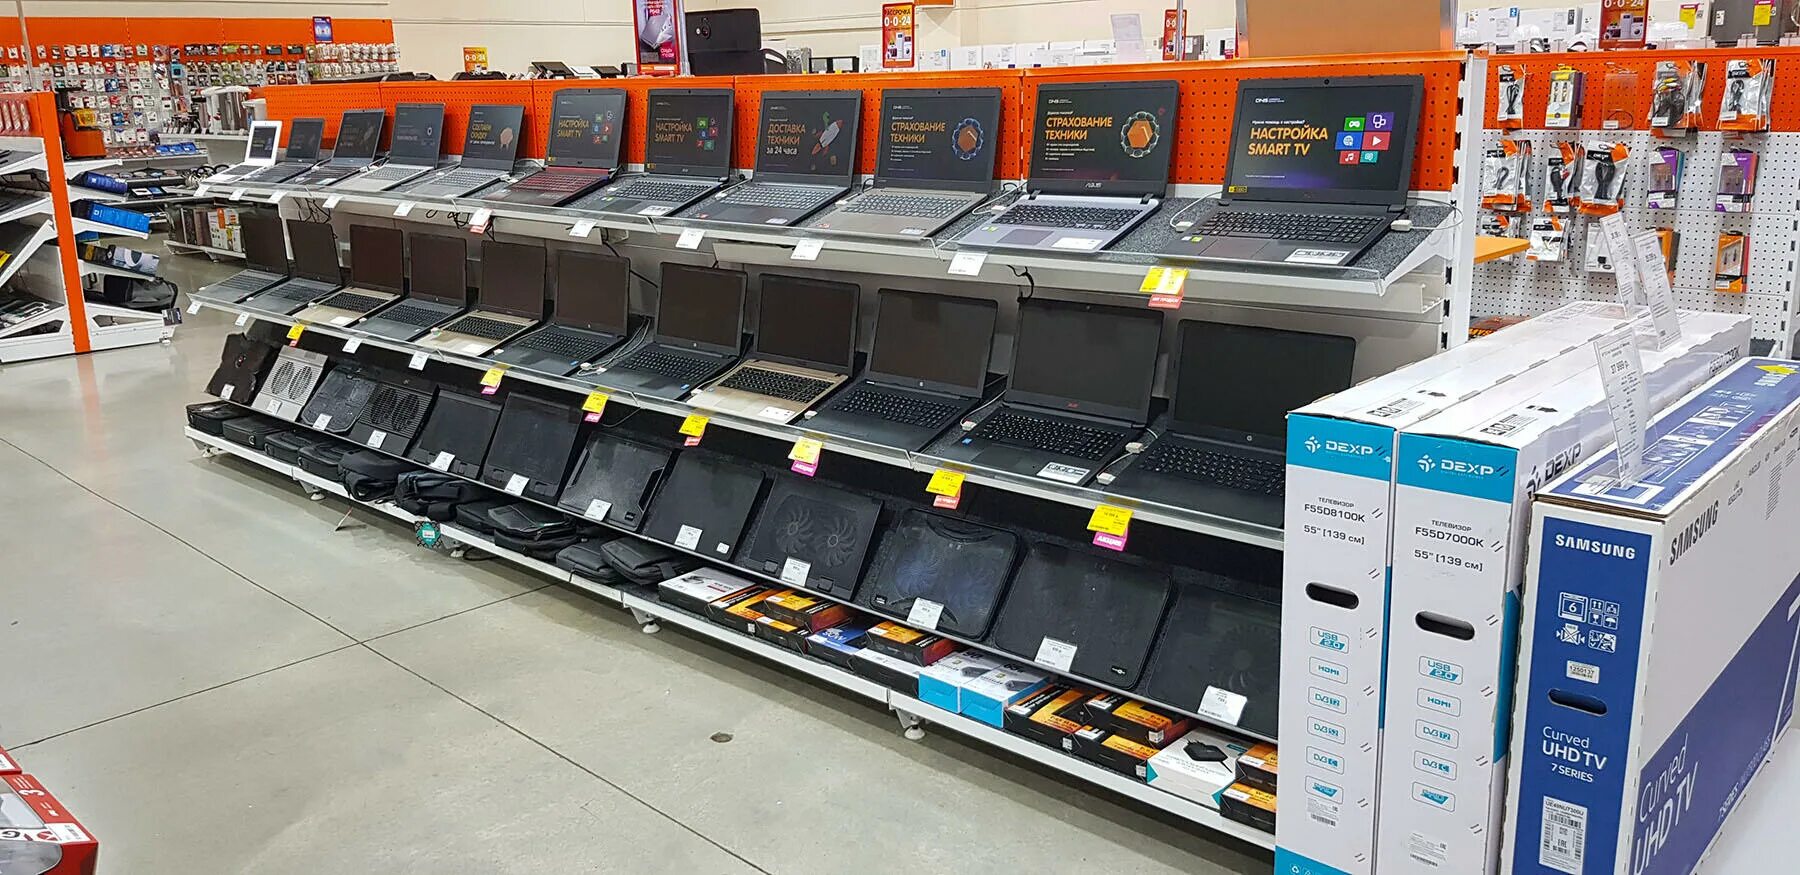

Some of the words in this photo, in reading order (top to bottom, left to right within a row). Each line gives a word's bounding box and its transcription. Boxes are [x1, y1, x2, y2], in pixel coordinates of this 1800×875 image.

[655, 121, 693, 132] НАСТРОЙКА
[891, 122, 946, 131] СТРАХОВАНИЕ
[1046, 117, 1113, 127] СТРАХОВАНИЕ
[767, 123, 806, 134] ДОСТАВКА
[1250, 124, 1328, 140] НАСТРОЙКА
[655, 133, 676, 142] SMART
[767, 135, 801, 145] ТЕХНИКИ
[890, 133, 926, 143] ТЕХНИКИ
[1045, 130, 1088, 140] ТЕХНИКИ
[766, 146, 774, 154] за
[774, 146, 782, 155] 24
[1247, 142, 1291, 155] SMART
[1294, 143, 1311, 156] TV
[1325, 440, 1374, 456] DEXP
[1441, 459, 1494, 476] DEXP
[1545, 442, 1582, 482] DEXP
[1318, 496, 1355, 508] ТЕЛЕВИЗОР
[1304, 503, 1366, 523] F55D8100K
[1303, 525, 1321, 535] 55"
[1431, 519, 1473, 532] ТЕЛЕВИЗОР
[1415, 526, 1485, 548] F55D7000K
[1669, 499, 1720, 566] SAMSUNG
[1555, 534, 1636, 560] SAMSUNG
[1414, 549, 1434, 560] 55"
[1568, 602, 1577, 613] 6
[1317, 630, 1338, 641] USB
[1318, 664, 1340, 676] HDMI
[1427, 660, 1451, 671] USB
[1427, 696, 1452, 709] HDMI
[1542, 725, 1590, 749] Curved
[1542, 741, 1581, 762] UHD
[1582, 753, 1608, 770] TV
[1551, 762, 1558, 772] 7
[1558, 765, 1594, 783] SERIES
[1639, 733, 1689, 823] Curved
[1633, 796, 1674, 875] UHD
[1674, 760, 1699, 827] TV
